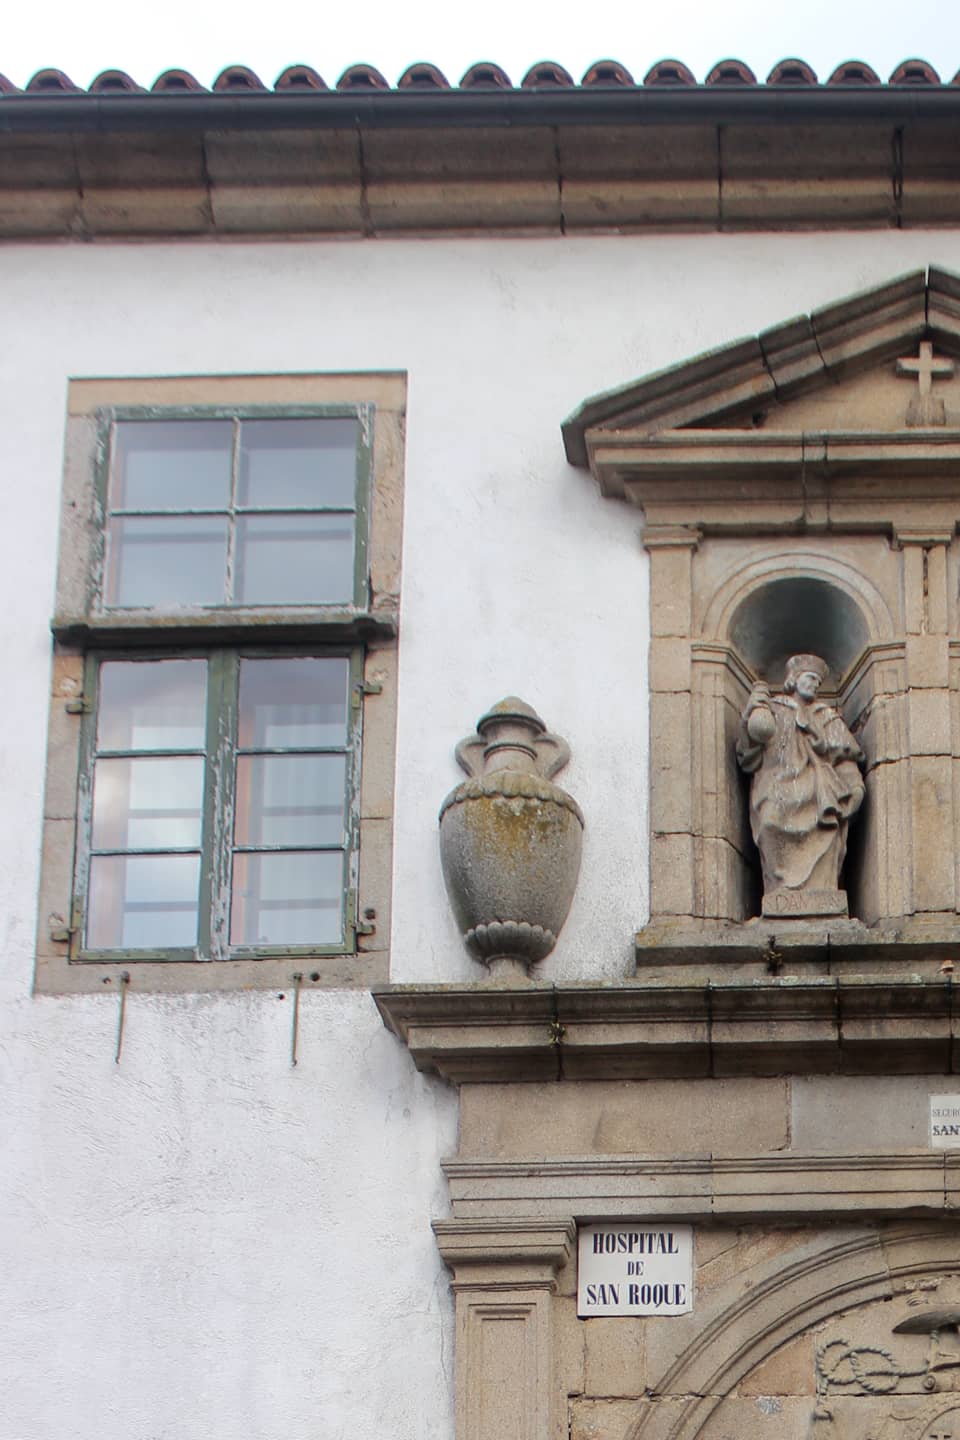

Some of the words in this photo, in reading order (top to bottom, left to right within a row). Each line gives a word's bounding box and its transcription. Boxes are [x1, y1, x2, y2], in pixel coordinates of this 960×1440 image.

[592, 1232, 679, 1254] HOSPITAL
[627, 1261, 645, 1276] DE
[586, 1283, 620, 1306] SAN
[628, 1283, 687, 1309] ROQUE
